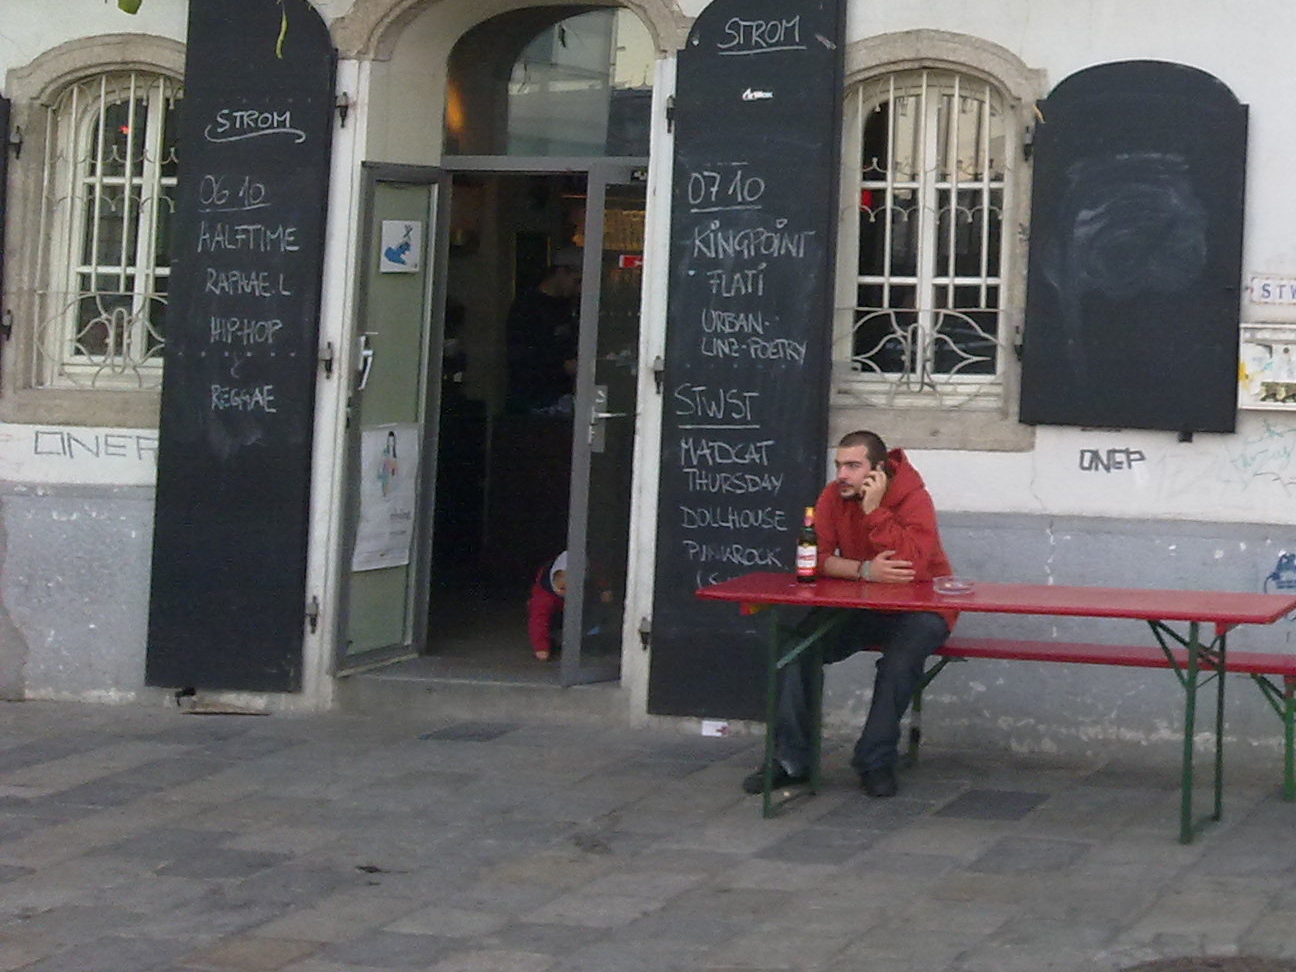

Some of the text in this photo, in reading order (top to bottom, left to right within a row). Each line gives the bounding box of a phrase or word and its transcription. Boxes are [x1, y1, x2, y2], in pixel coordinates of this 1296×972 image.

[717, 15, 801, 49] STROM
[216, 109, 291, 133] STROM
[196, 220, 300, 253] HALFTIME
[674, 383, 760, 420] STWST
[680, 436, 775, 466] MADCAT
[682, 468, 784, 496] THURSDAY
[679, 506, 788, 531] DOLLHOUSE
